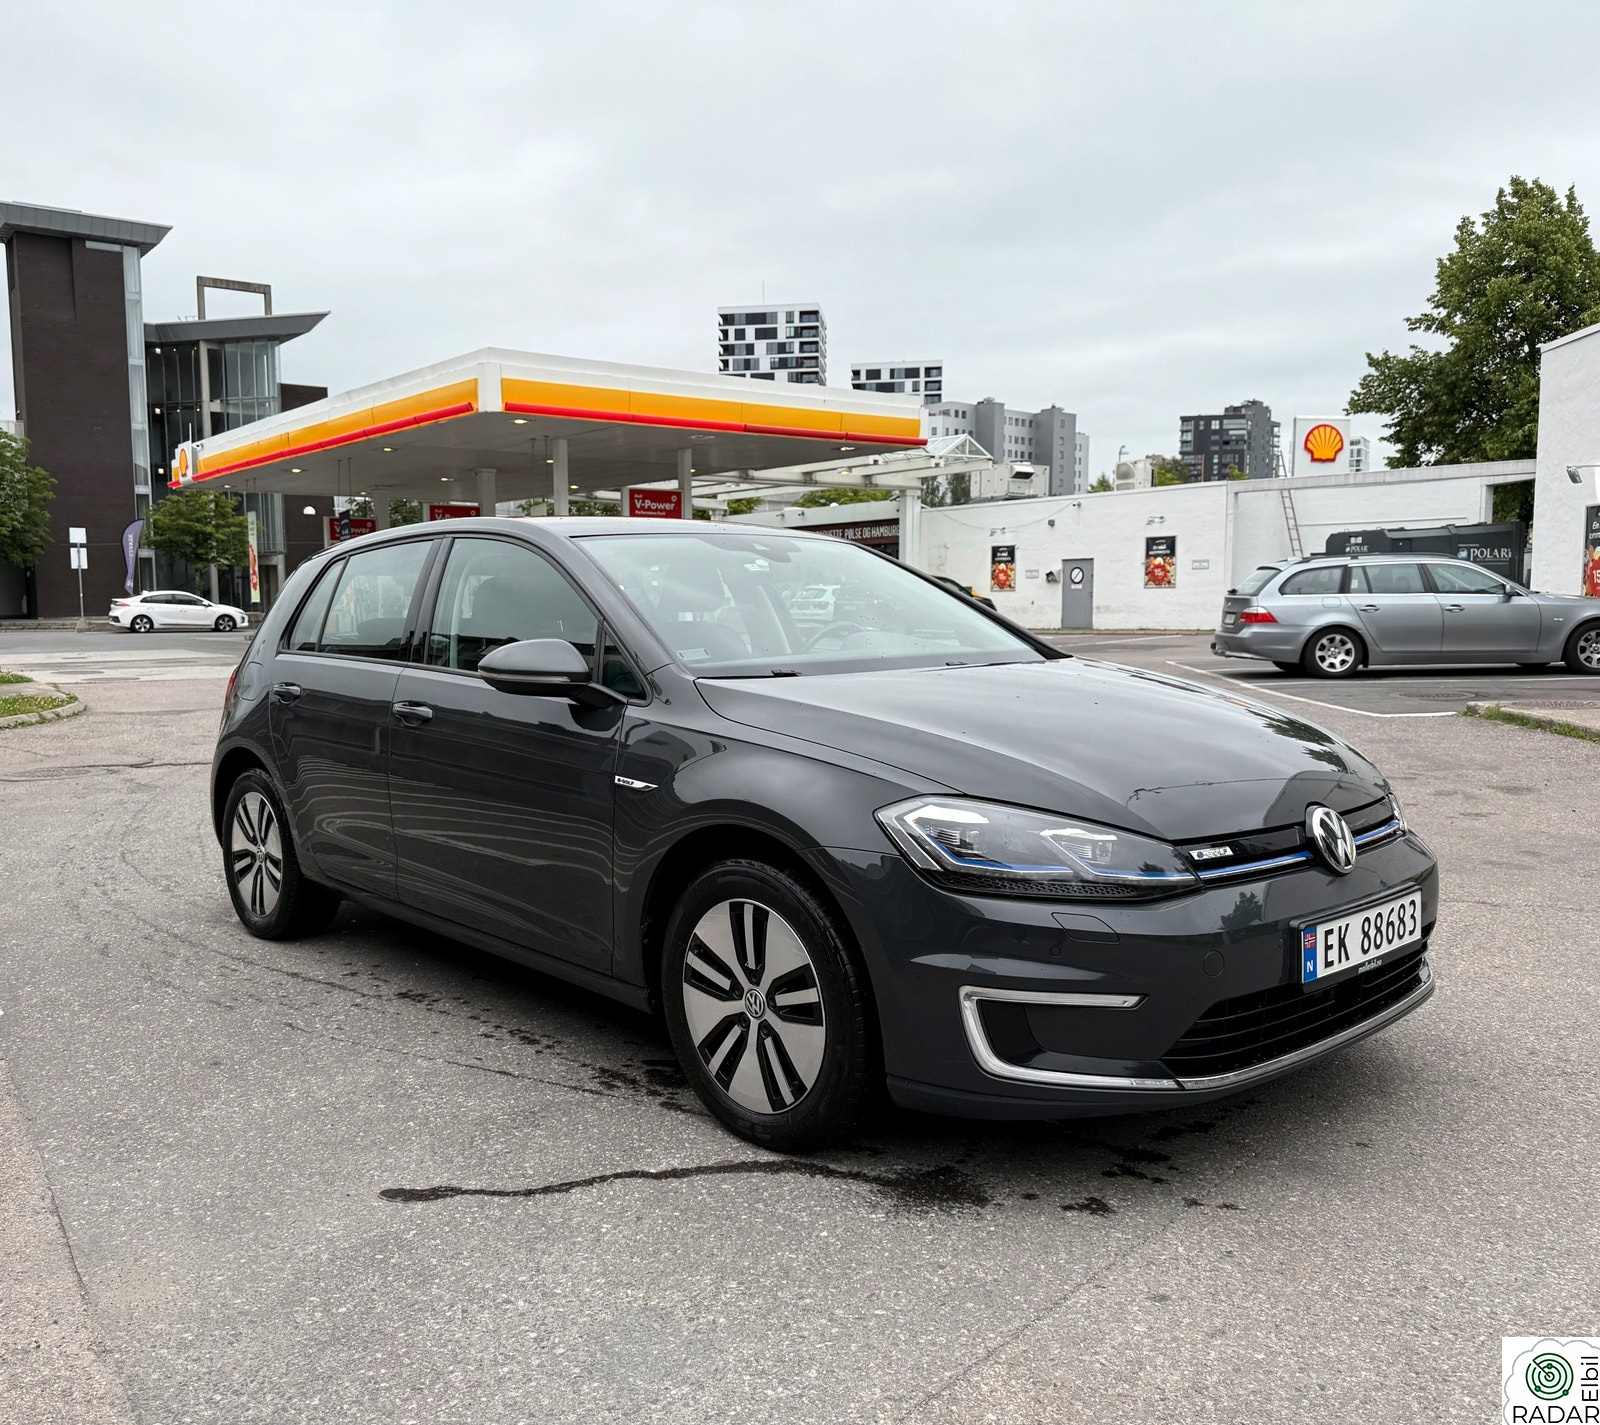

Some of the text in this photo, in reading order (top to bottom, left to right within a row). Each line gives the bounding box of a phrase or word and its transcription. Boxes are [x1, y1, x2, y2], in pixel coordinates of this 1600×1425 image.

[634, 499, 676, 510] V-Power
[845, 528, 862, 540] PØLSE
[862, 526, 871, 538] OG
[1306, 899, 1416, 972] N EK 88683
